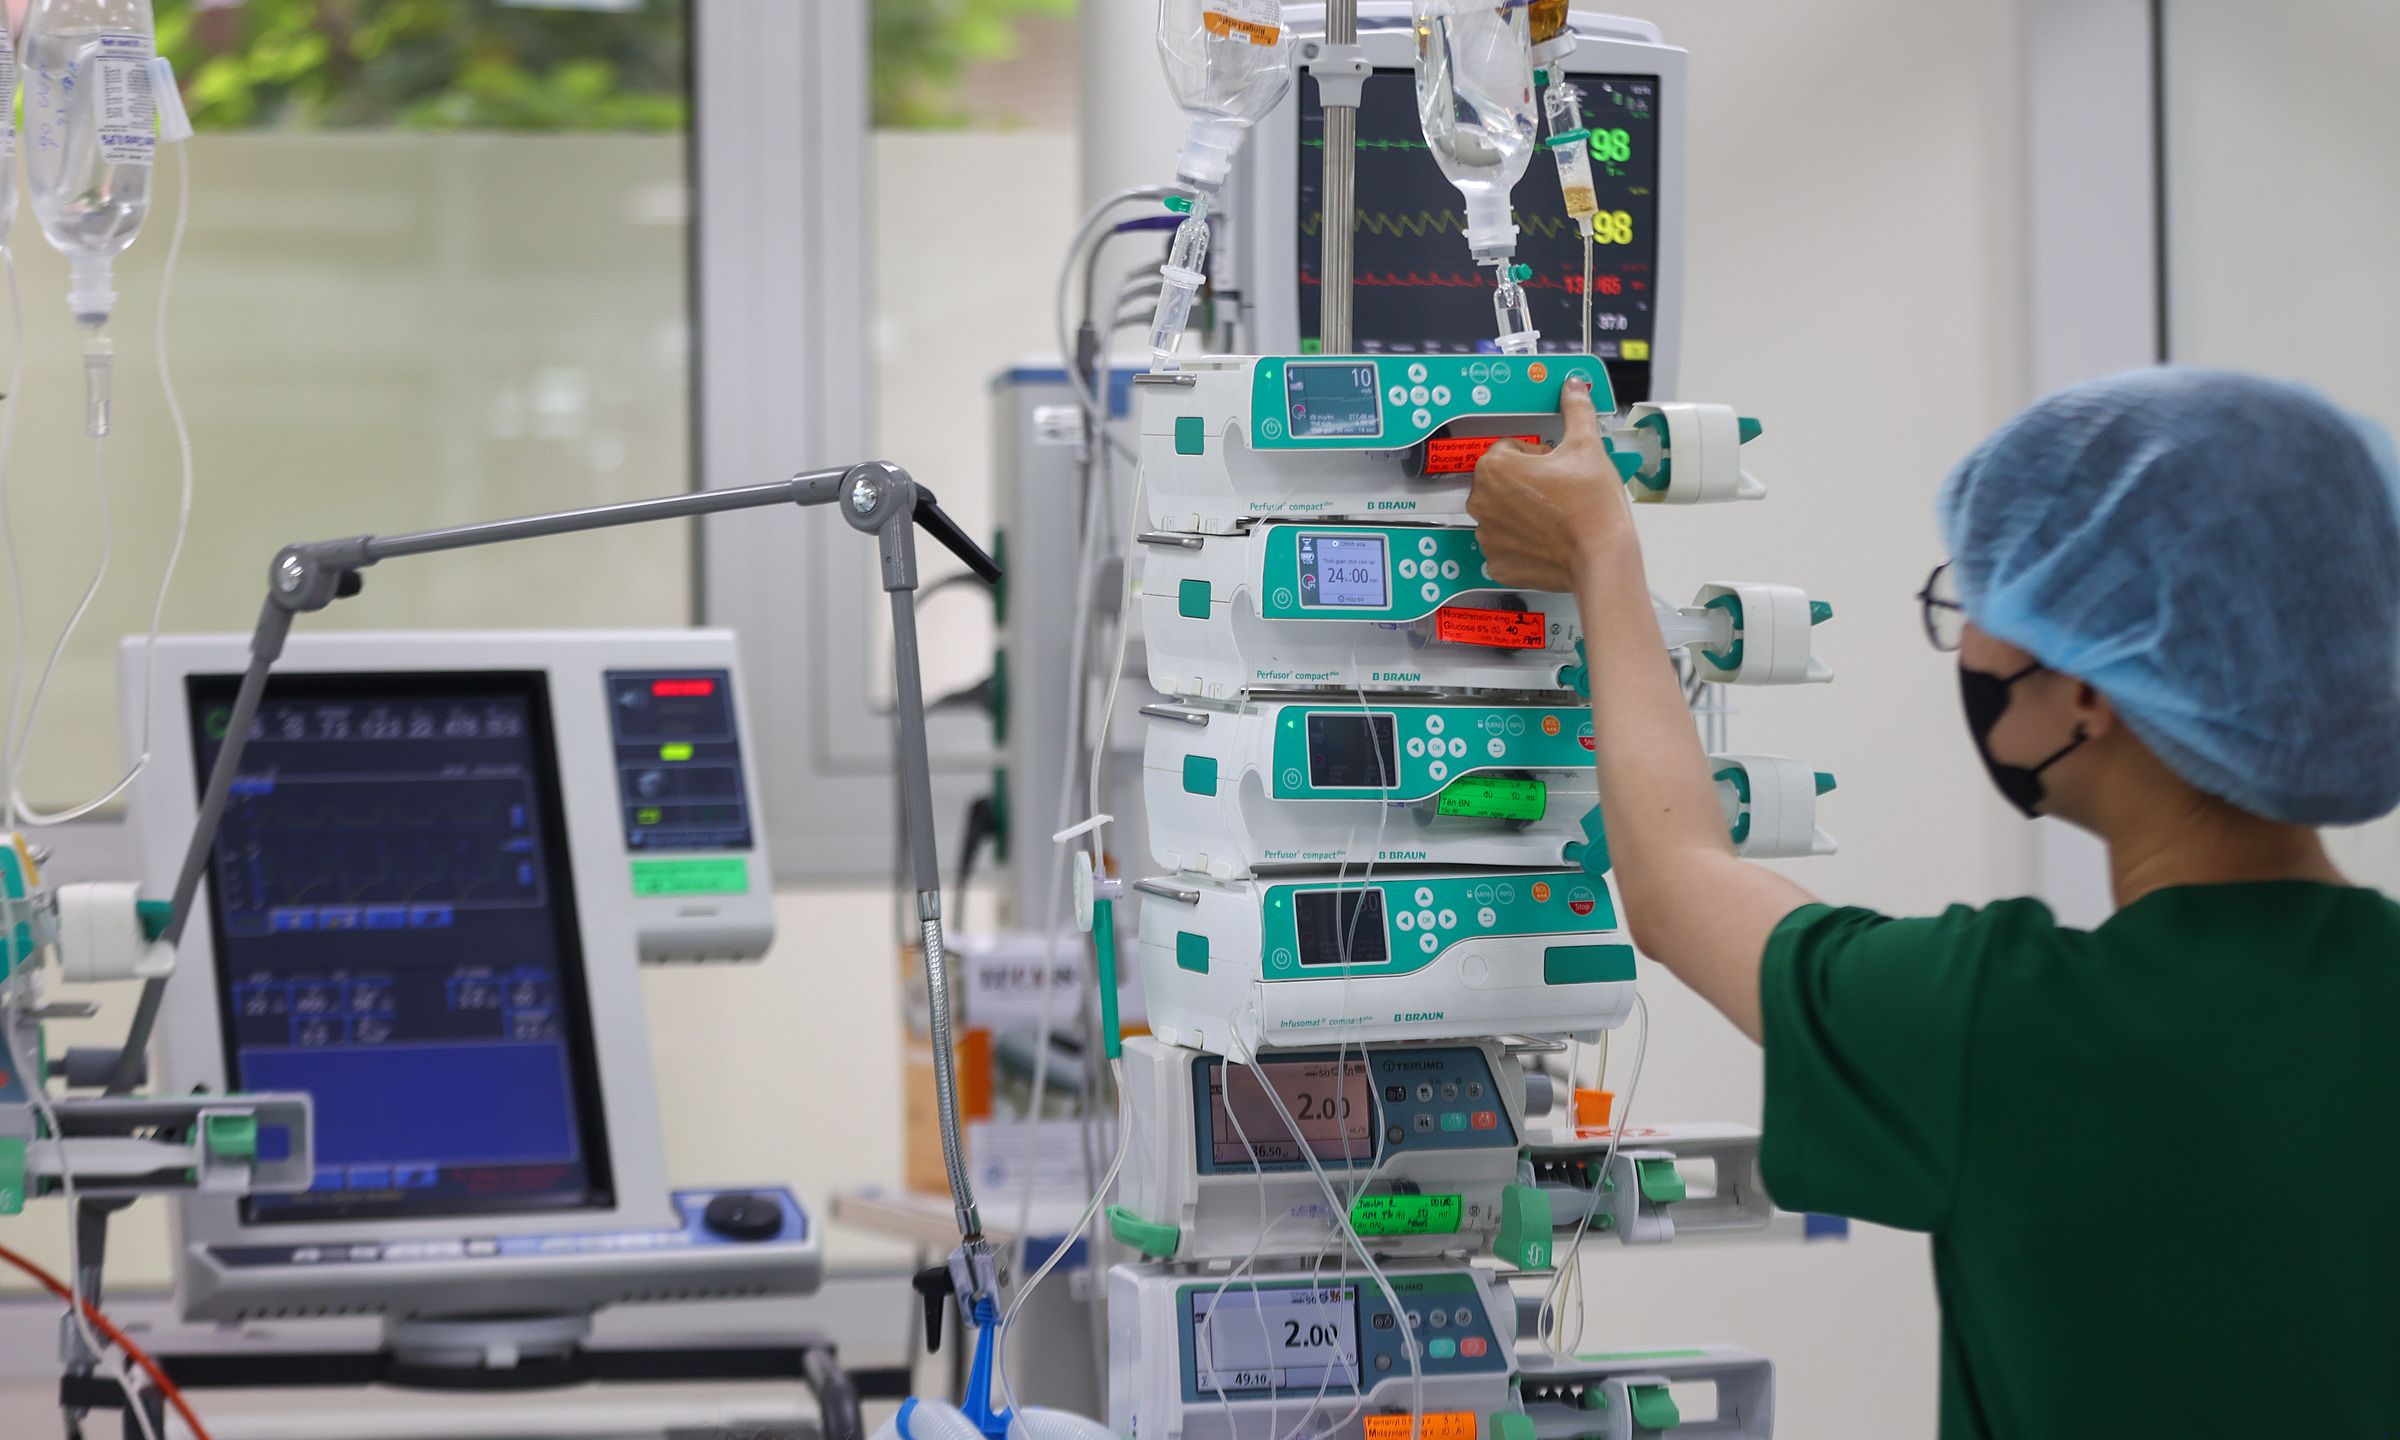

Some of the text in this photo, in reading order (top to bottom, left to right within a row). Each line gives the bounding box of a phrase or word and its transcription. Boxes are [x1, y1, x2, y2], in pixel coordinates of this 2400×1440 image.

[1590, 127, 1631, 162] 98
[1593, 210, 1633, 244] 98
[1352, 368, 1371, 387] 10
[1494, 369, 1508, 377] INFO
[1431, 441, 1480, 452] Noradrenalin
[1431, 454, 1463, 463] Glucose
[1378, 501, 1416, 510] BRAUN
[1424, 565, 1434, 573] OK
[1443, 610, 1492, 622] Noradrenalin
[1493, 614, 1511, 625] 4mg
[1443, 621, 1475, 632] Glucose
[1476, 626, 1489, 634] 5%
[1383, 672, 1421, 682] BRAUN
[1441, 797, 1456, 806] Tên
[1389, 851, 1426, 860] BRAUN
[1476, 889, 1494, 898] MENU
[1499, 889, 1513, 897] INFO
[1535, 885, 1547, 893] BOL
[1575, 903, 1590, 912] Stop
[1405, 1012, 1444, 1022] BRAUN
[1396, 1061, 1444, 1071] TERUMO
[1297, 1093, 1350, 1120] 2.00
[1284, 1320, 1338, 1348] 2.00
[1235, 1373, 1267, 1386] 49.10
[1368, 1428, 1410, 1438] Midazolam
